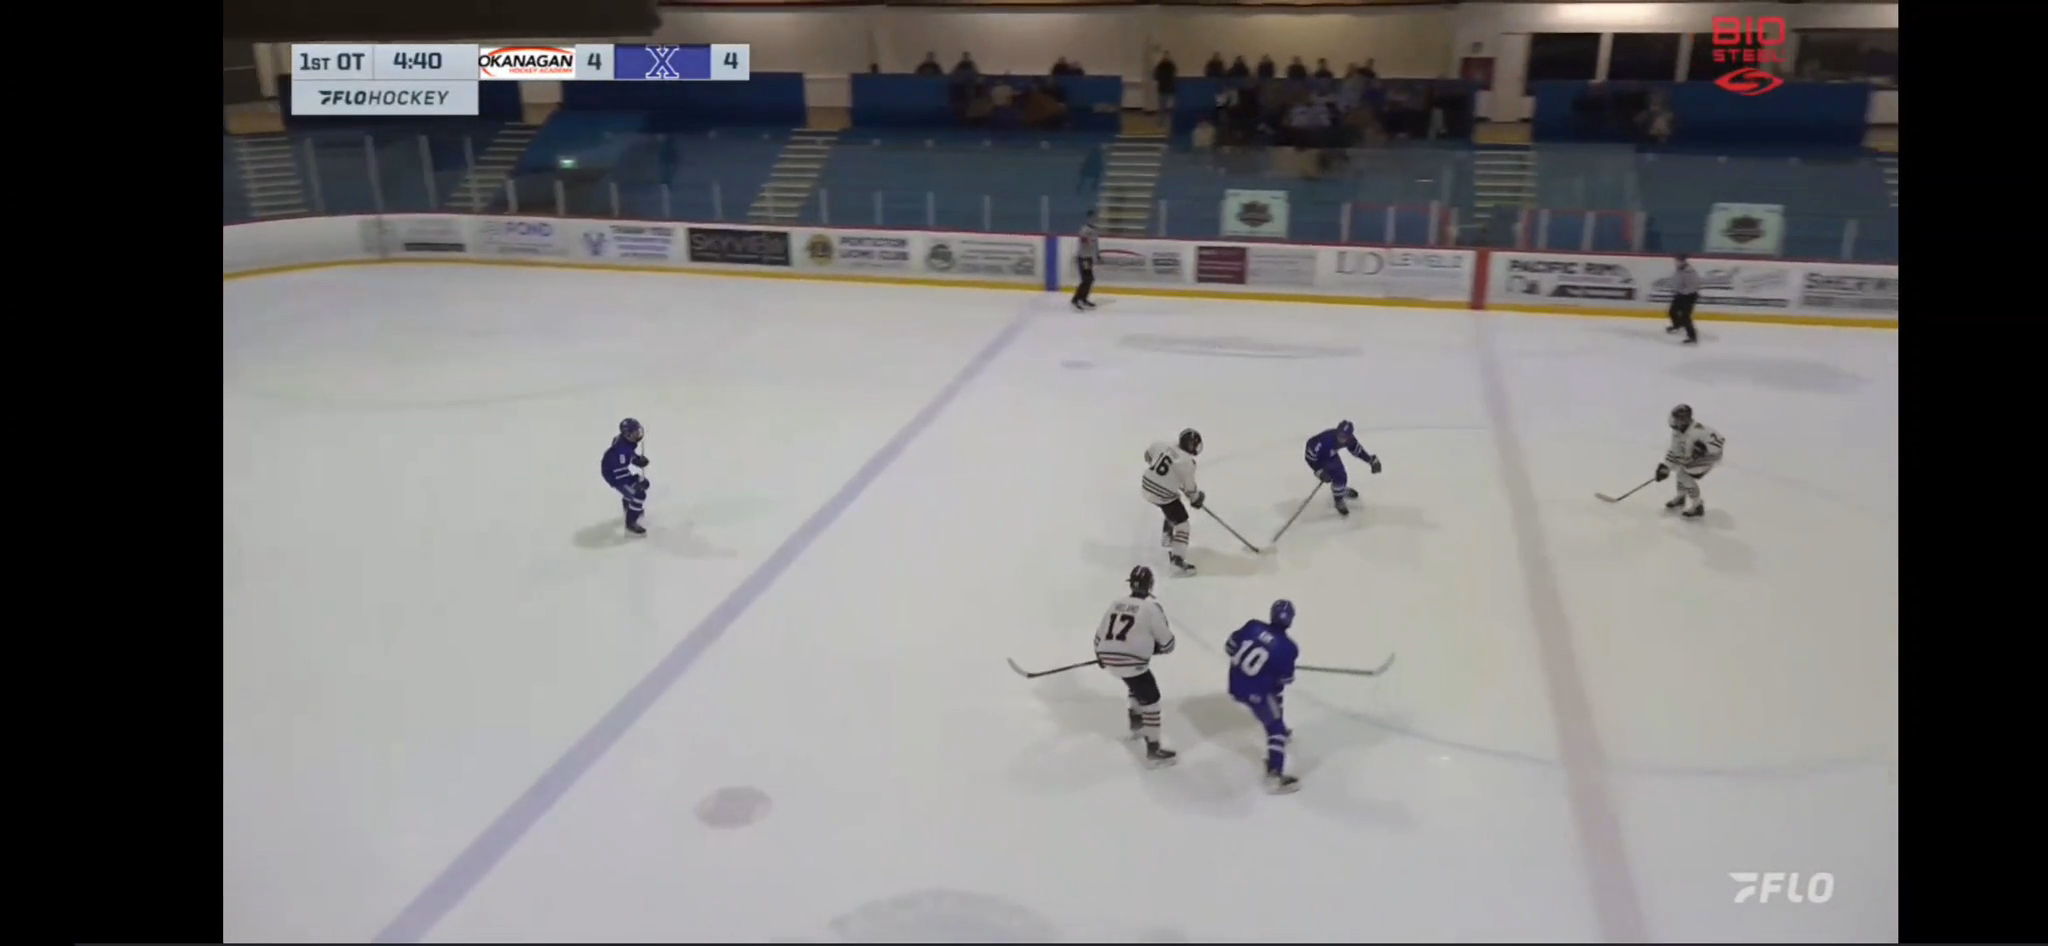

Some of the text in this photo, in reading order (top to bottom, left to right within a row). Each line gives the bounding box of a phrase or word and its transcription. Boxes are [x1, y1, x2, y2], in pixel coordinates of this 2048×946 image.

[1149, 452, 1174, 477] 16
[1104, 613, 1136, 641] 17
[1231, 639, 1270, 677] 10
